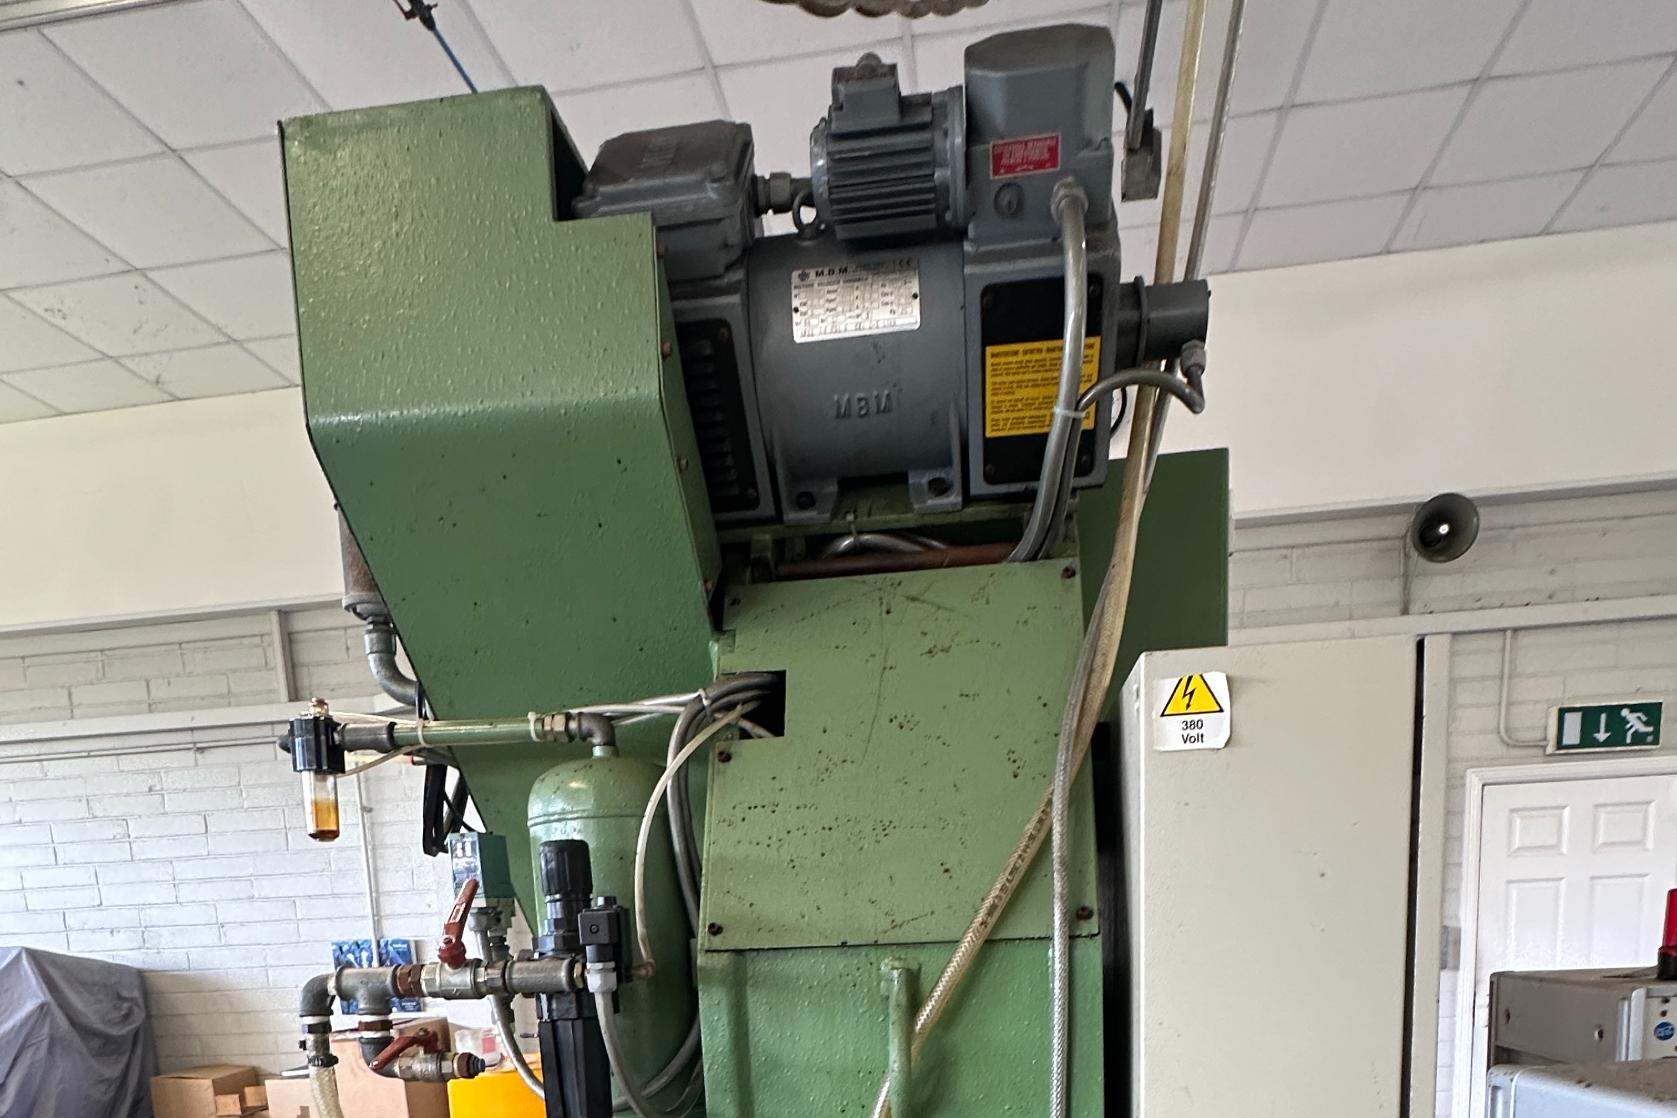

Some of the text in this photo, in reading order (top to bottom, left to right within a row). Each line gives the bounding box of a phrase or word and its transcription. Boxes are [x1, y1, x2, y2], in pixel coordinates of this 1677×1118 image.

[834, 390, 892, 420] MBM
[1181, 719, 1204, 731] 380
[1181, 732, 1204, 744] Volt
